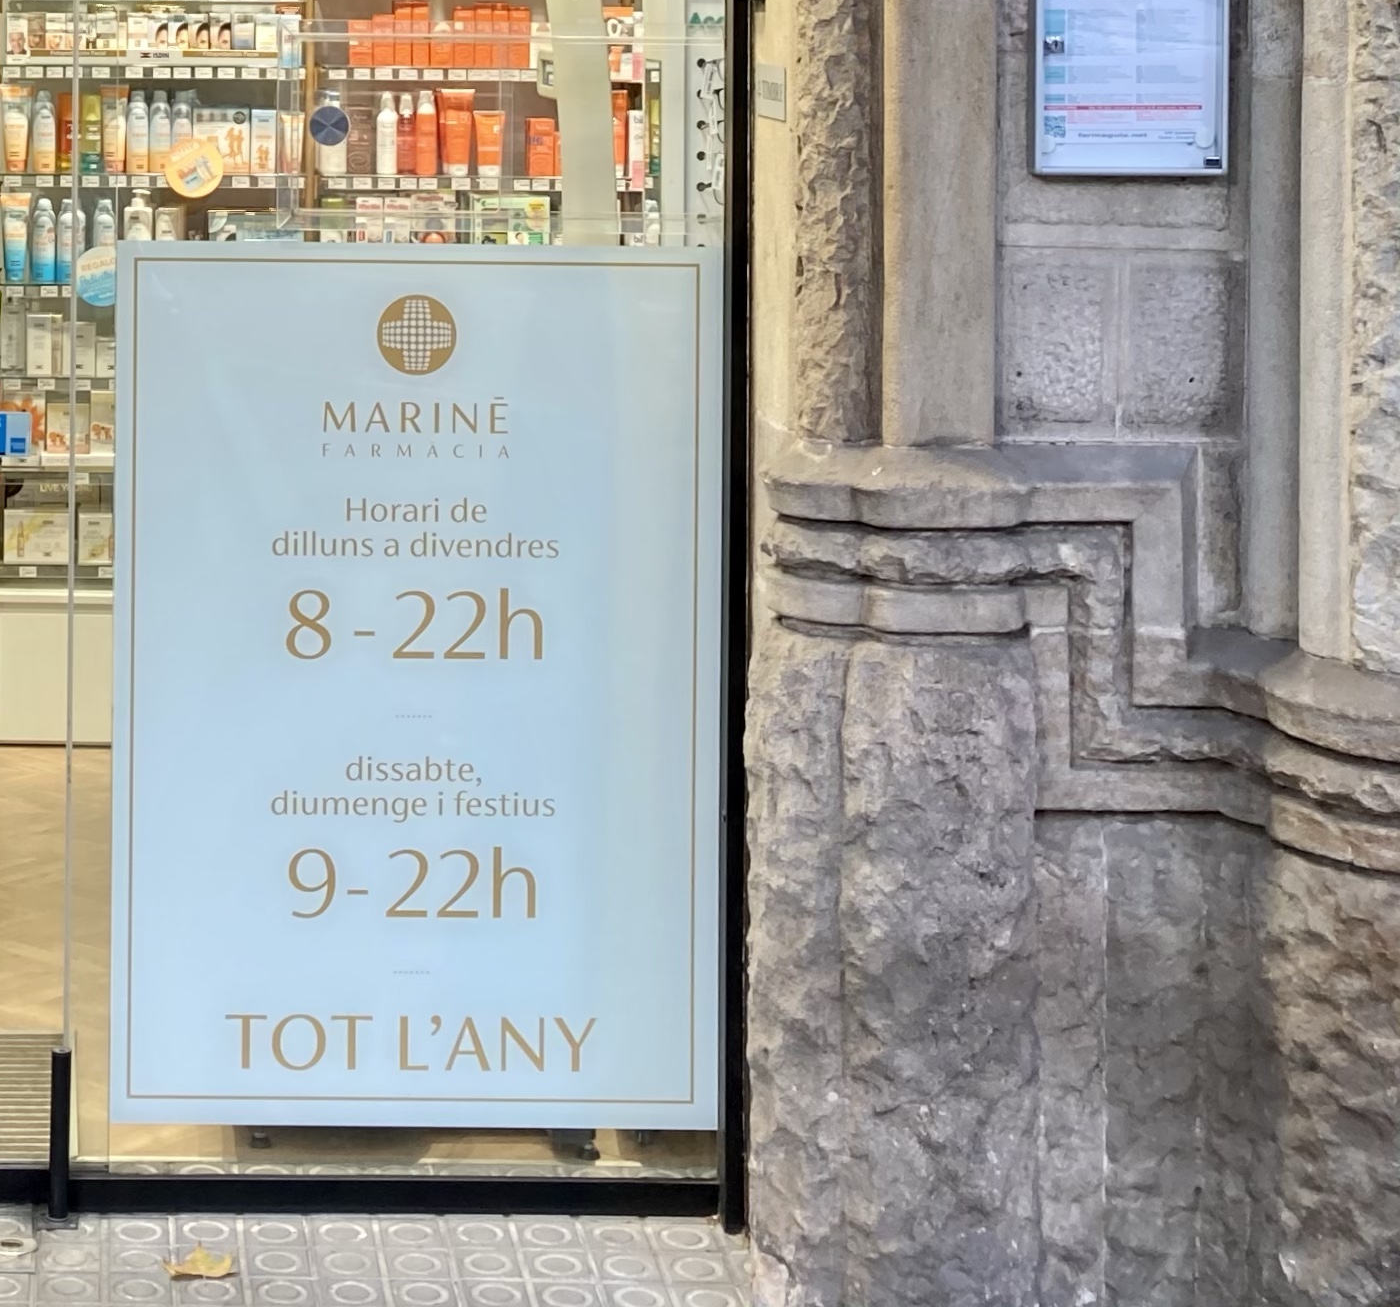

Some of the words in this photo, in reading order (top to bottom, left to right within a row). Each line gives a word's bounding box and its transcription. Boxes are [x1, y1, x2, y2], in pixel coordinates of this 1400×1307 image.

[345, 496, 440, 523] Horari
[450, 497, 488, 523] de
[271, 530, 375, 557] dilluns
[383, 538, 401, 558] a
[409, 531, 560, 559] divendres
[285, 589, 332, 660] 8
[392, 587, 544, 661] 22h
[345, 755, 483, 787] dissabte,
[270, 790, 428, 823] diumenge
[436, 791, 445, 817] i
[454, 790, 556, 818] festius
[224, 1013, 374, 1072] TOT
[399, 1014, 599, 1073] L’ANY
